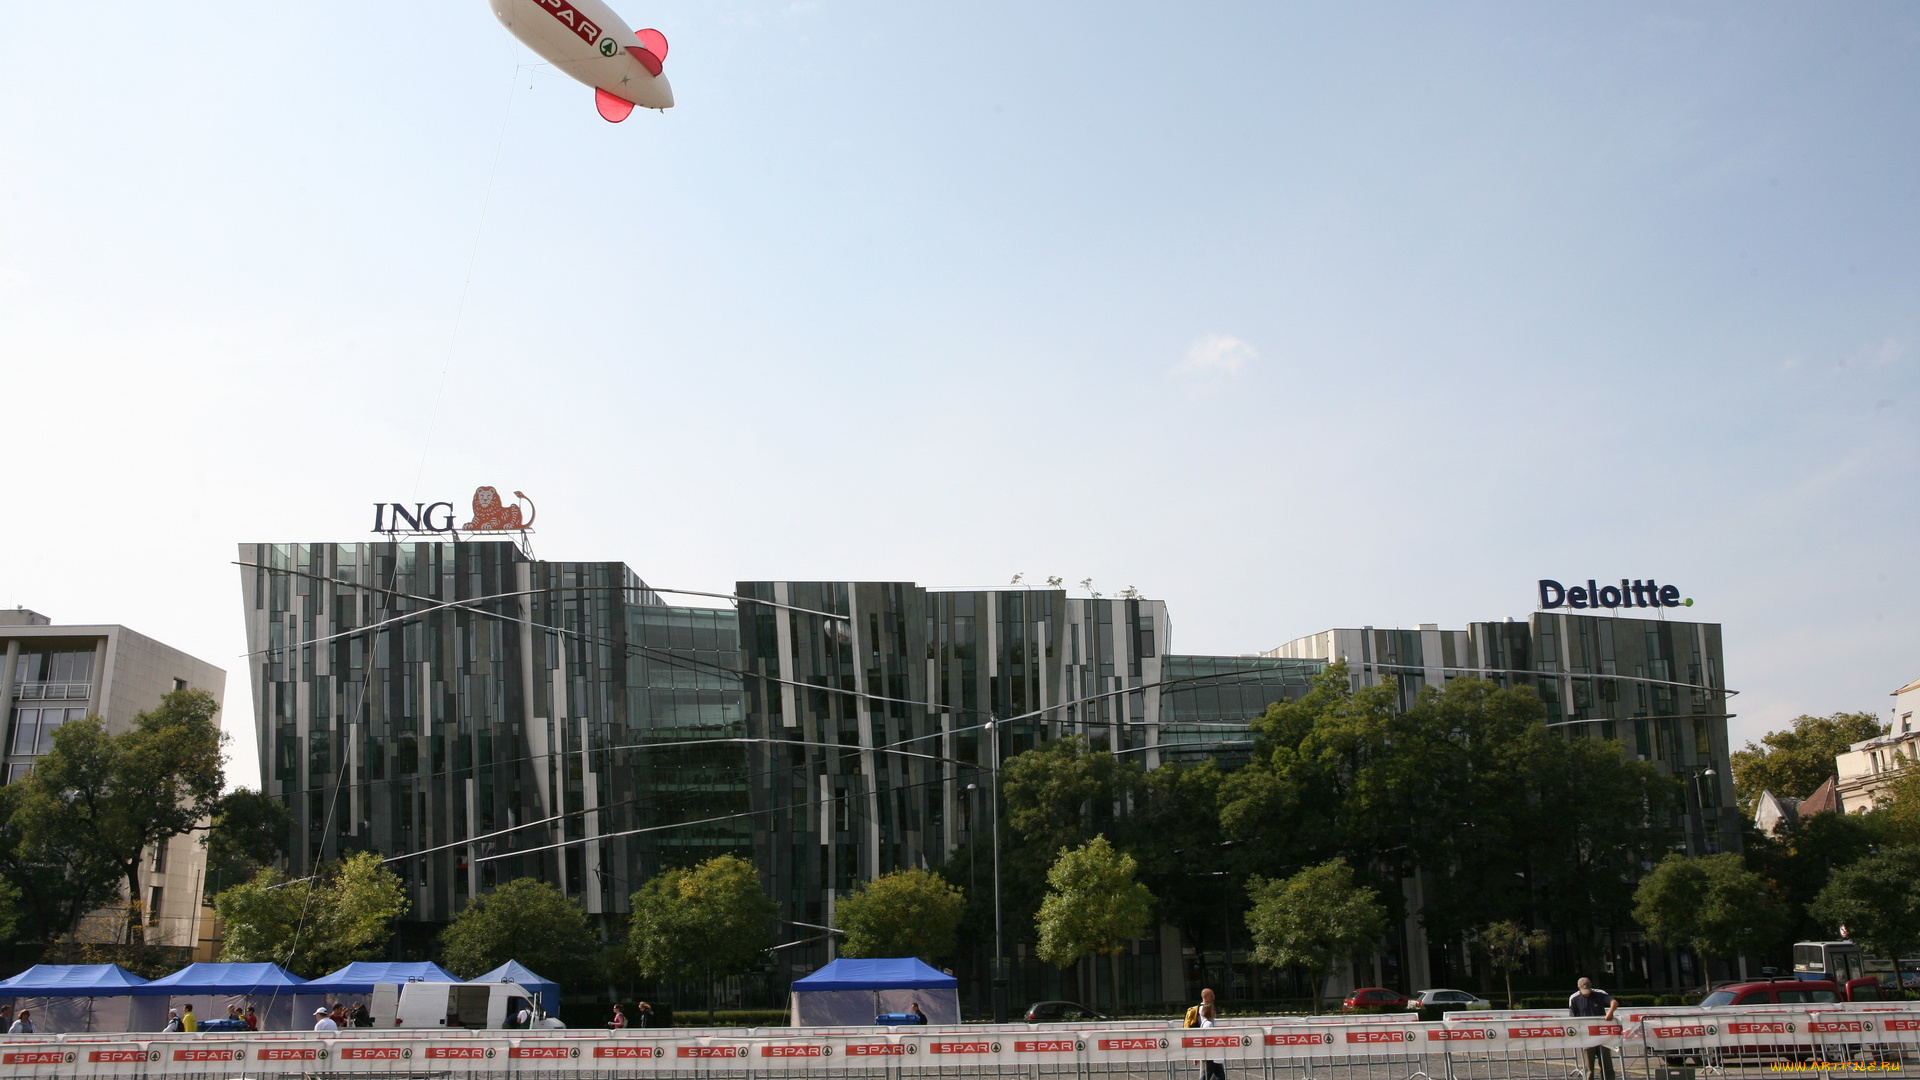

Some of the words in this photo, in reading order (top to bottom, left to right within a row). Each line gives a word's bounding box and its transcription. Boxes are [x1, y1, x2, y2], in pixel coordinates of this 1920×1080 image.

[370, 502, 456, 533] ING
[1739, 1024, 1784, 1033] SPAR
[1816, 1022, 1861, 1032] SPAR
[1895, 1021, 1920, 1030] SP
[1438, 1030, 1484, 1040] SPAR
[1518, 1028, 1564, 1038] SPAR
[1660, 1026, 1705, 1037] SPAR
[1192, 1037, 1239, 1047] SPAR
[1275, 1035, 1321, 1045] SPAR
[1356, 1032, 1403, 1042] SPAR
[941, 1043, 988, 1053] SPAR
[1025, 1042, 1072, 1051] SPAR
[1109, 1040, 1156, 1049] SPAR
[268, 1050, 316, 1060] SPAR
[352, 1049, 400, 1059] SPAR
[435, 1049, 483, 1058] SPAR
[520, 1048, 568, 1058] SPAR
[604, 1048, 651, 1057] SPAR
[688, 1047, 735, 1057] SPAR
[772, 1047, 820, 1056] SPAR
[856, 1045, 904, 1055] SPAR
[14, 1053, 62, 1063] SPAR
[99, 1052, 146, 1061] SPAR
[184, 1051, 232, 1060] SPAR
